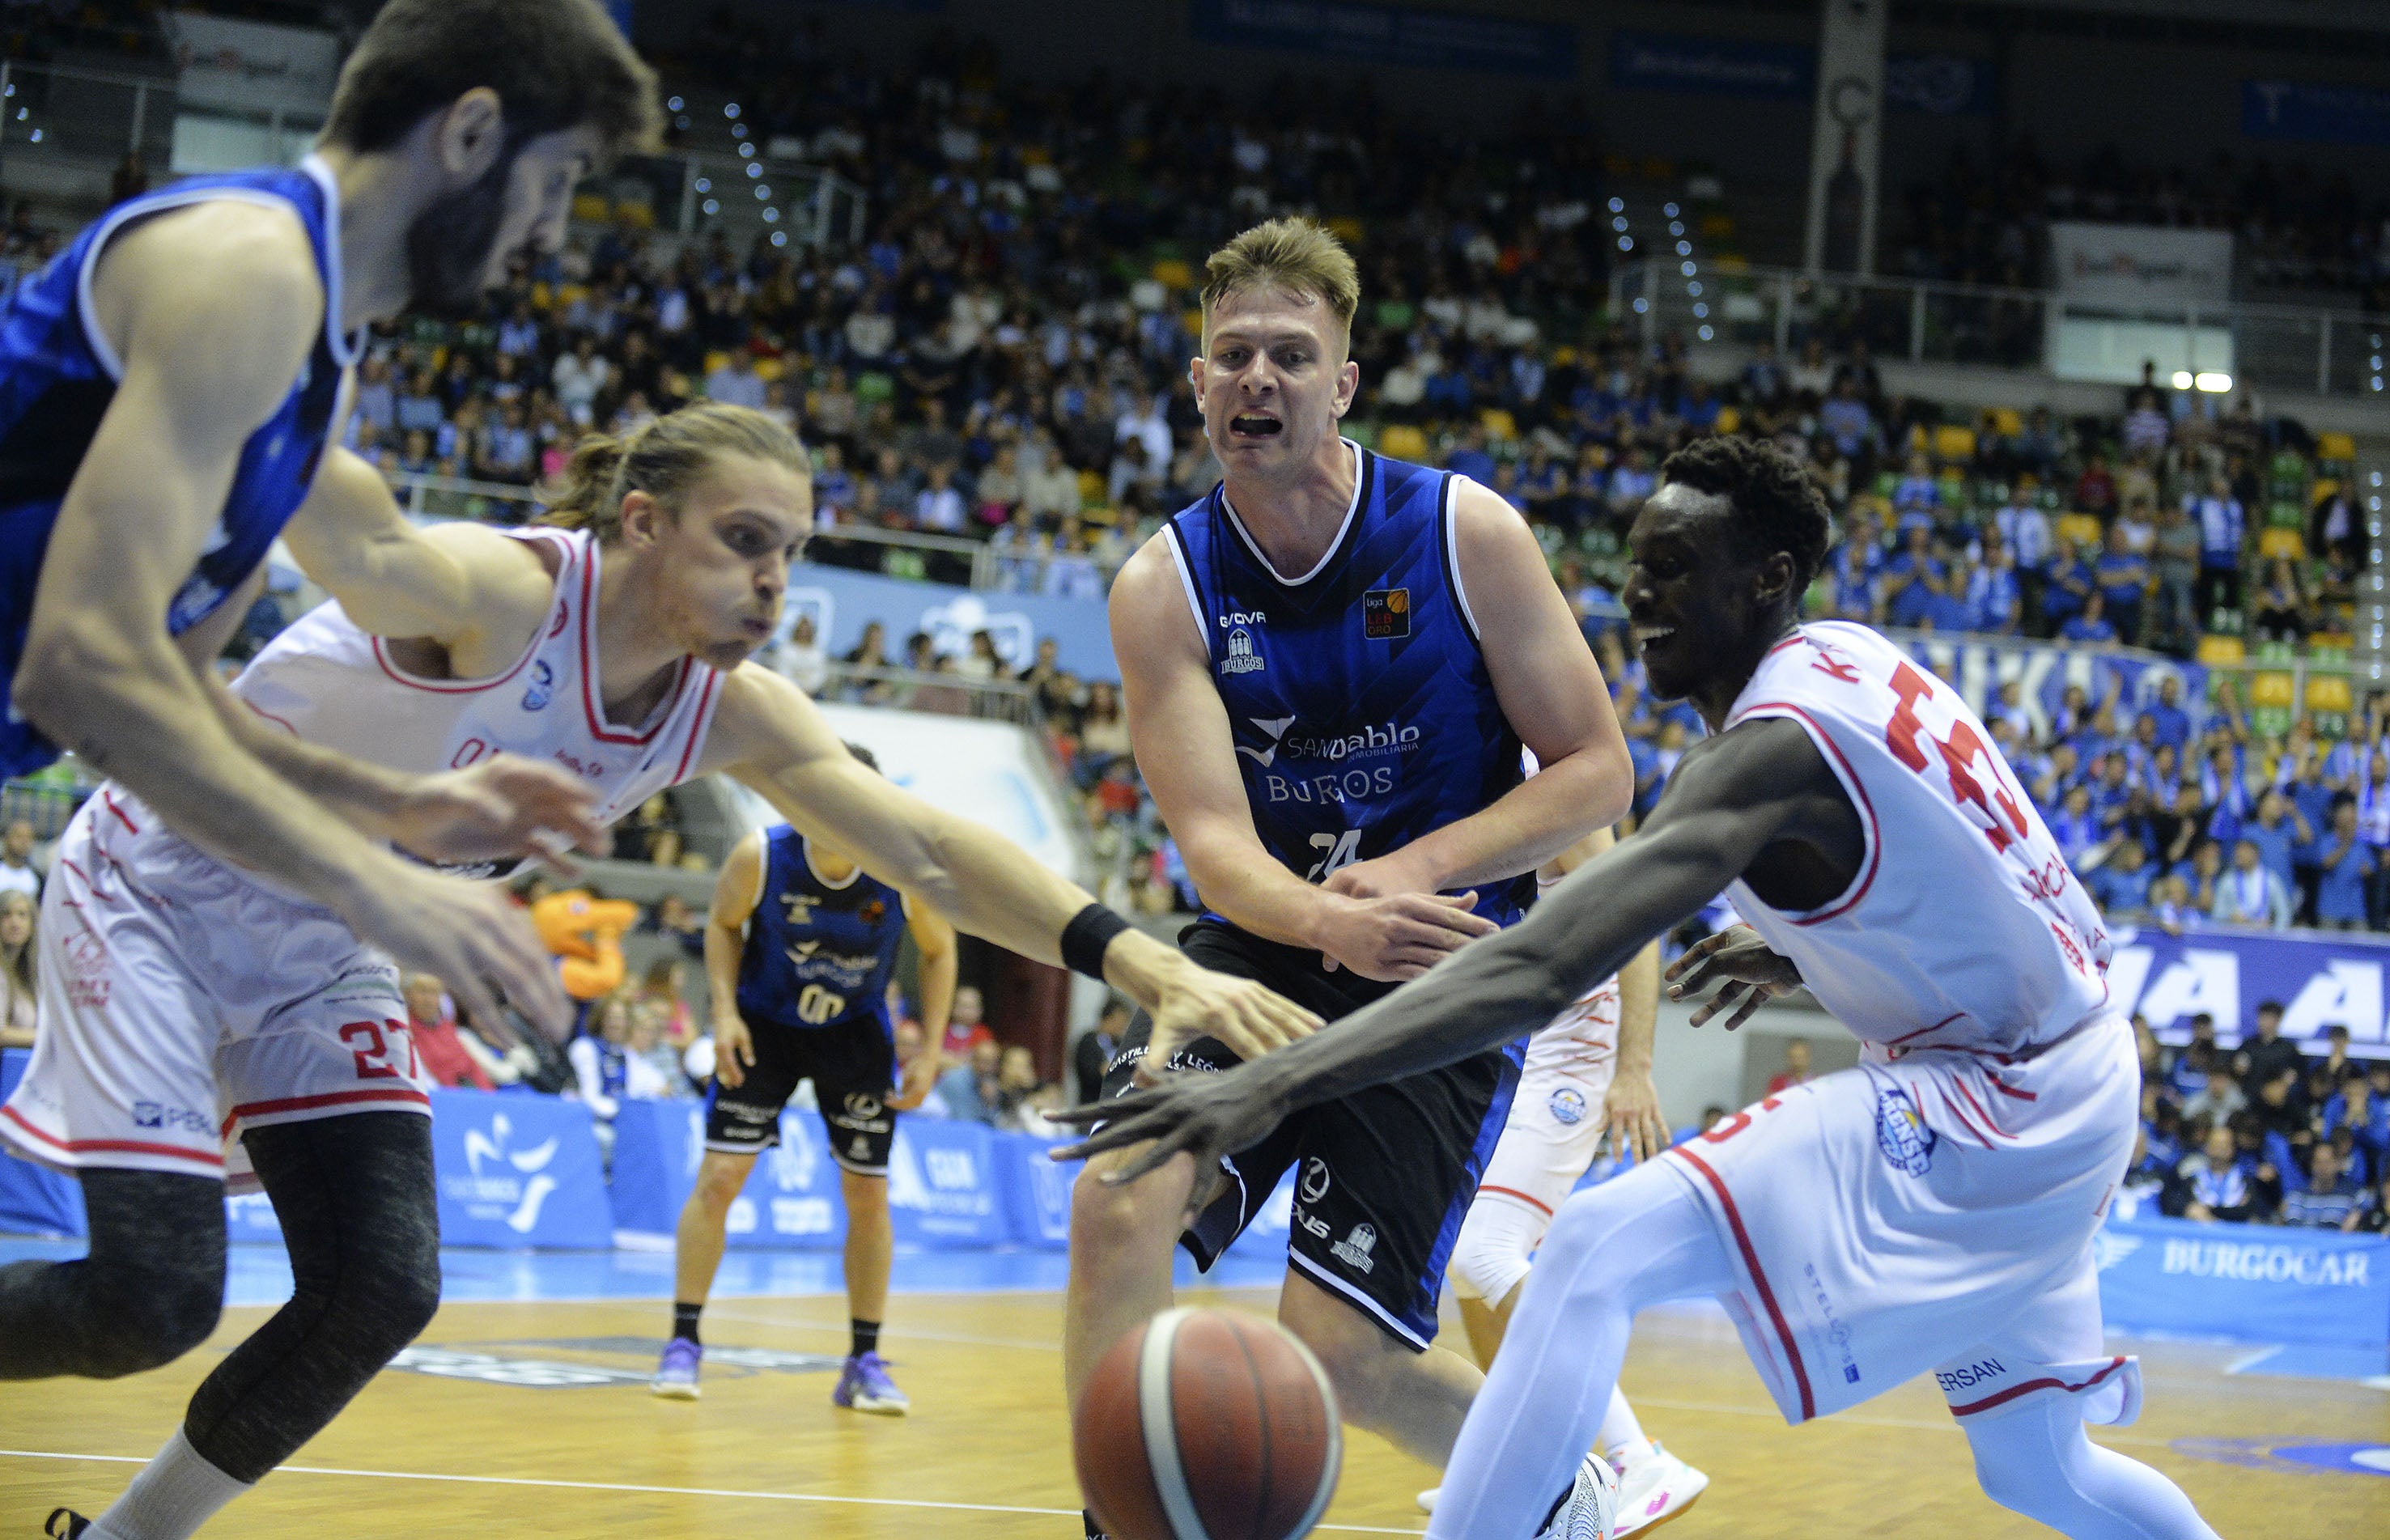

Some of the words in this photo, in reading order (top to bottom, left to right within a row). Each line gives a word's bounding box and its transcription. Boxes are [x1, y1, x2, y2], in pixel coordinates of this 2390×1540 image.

[1366, 598, 1383, 609] Liga
[1367, 613, 1392, 626] LEB
[1368, 625, 1391, 635] ORO
[1225, 659, 1262, 670] BURGOS
[338, 1017, 418, 1080] 27
[2162, 1238, 2370, 1286] BURGOCAR
